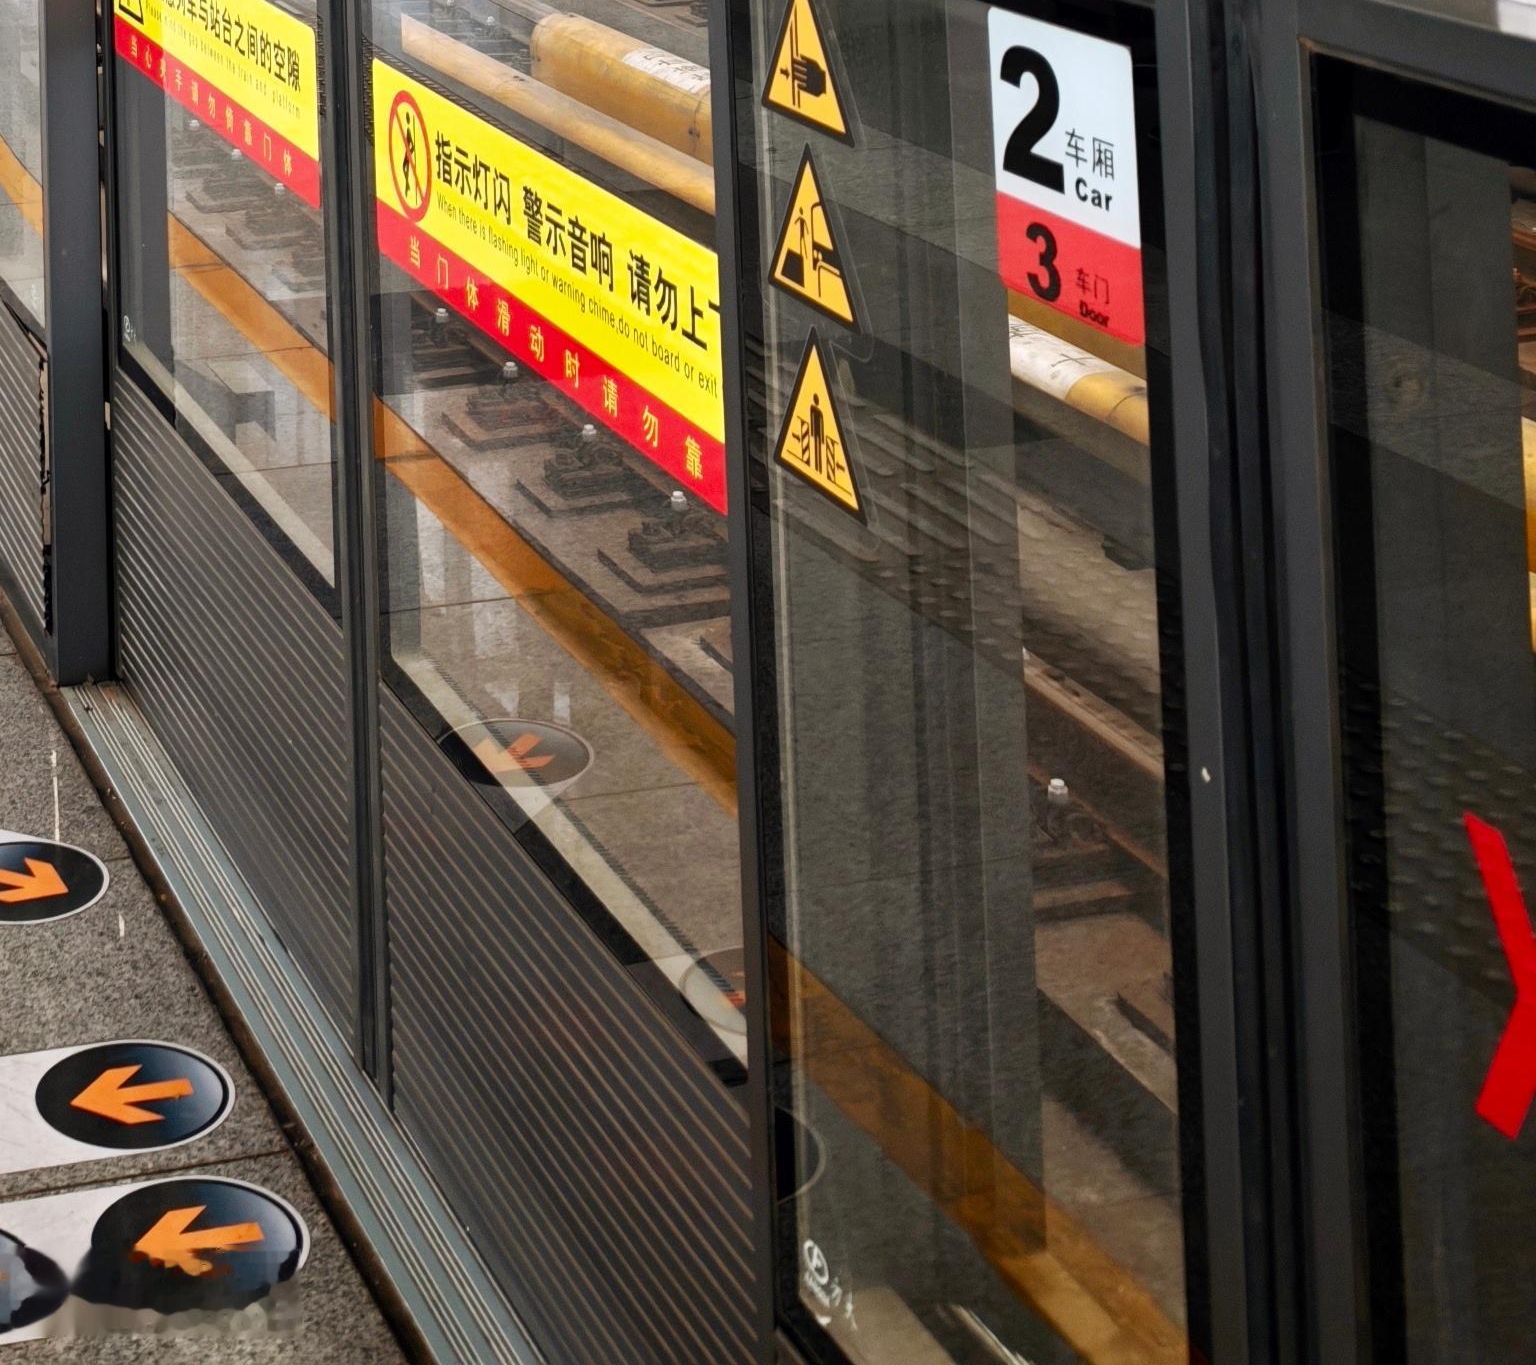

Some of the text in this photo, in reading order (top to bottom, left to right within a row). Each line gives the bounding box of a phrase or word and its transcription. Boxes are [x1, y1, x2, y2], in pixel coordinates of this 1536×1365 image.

[255, 77, 267, 96] and
[272, 89, 302, 120] platform
[1000, 44, 1066, 196] 2
[1065, 127, 1115, 181] 车厢
[1075, 176, 1113, 212] Car
[435, 130, 721, 352] 指示灯闪 警示音响 请勿上
[1025, 221, 1062, 303] 3
[436, 191, 457, 217] When
[459, 204, 478, 235] there
[479, 218, 487, 241] is
[488, 225, 519, 267] flashing
[520, 243, 539, 277] light
[541, 265, 550, 281] or
[551, 271, 586, 313] warning
[633, 327, 650, 353] not
[652, 335, 681, 373] board
[684, 362, 695, 382] or
[698, 370, 719, 399] exit
[1075, 266, 1110, 306] 车门
[1078, 299, 1111, 329] Door
